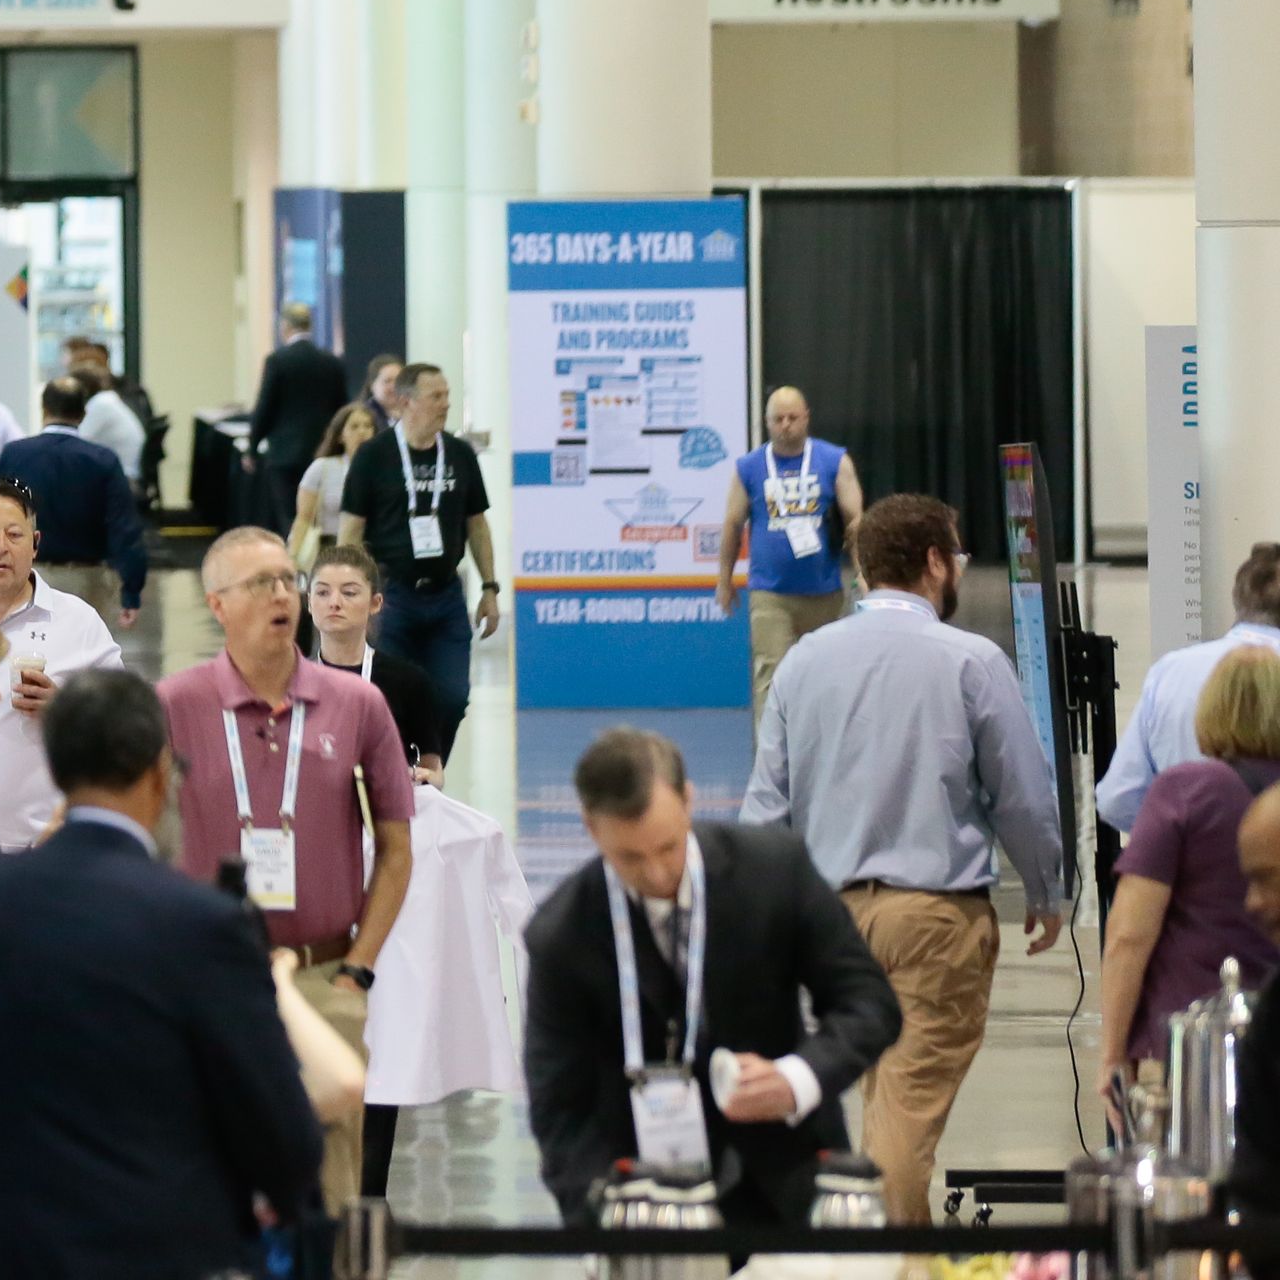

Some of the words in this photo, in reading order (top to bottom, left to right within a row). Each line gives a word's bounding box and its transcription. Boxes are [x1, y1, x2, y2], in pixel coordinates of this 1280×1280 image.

[511, 233, 553, 264] 365
[556, 232, 694, 263] DAYS-A-YEAR
[550, 302, 630, 323] TRAINING
[635, 301, 695, 322] GUIDES
[557, 329, 590, 350] AND
[593, 328, 690, 350] PROGRAMS
[521, 550, 657, 572] CERTIFICATIONS
